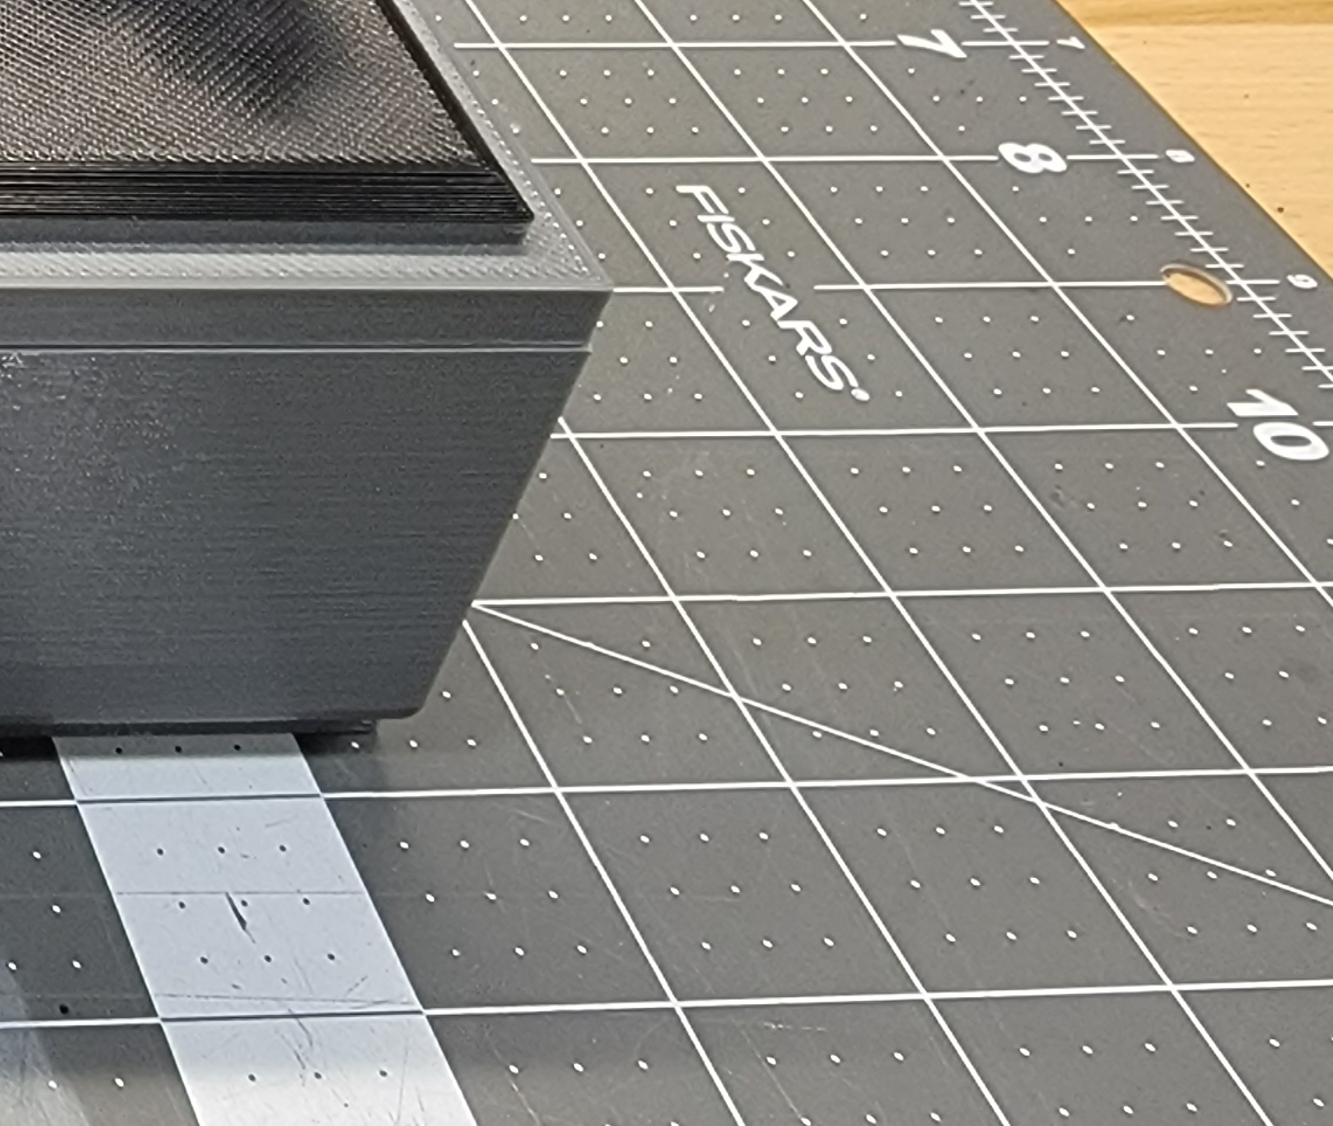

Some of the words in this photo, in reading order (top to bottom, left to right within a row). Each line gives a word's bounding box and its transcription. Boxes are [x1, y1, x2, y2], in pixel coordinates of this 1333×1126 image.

[897, 29, 968, 58] 7
[998, 142, 1067, 174] 8
[1287, 274, 1318, 289] 9
[1226, 388, 1329, 461] 10
